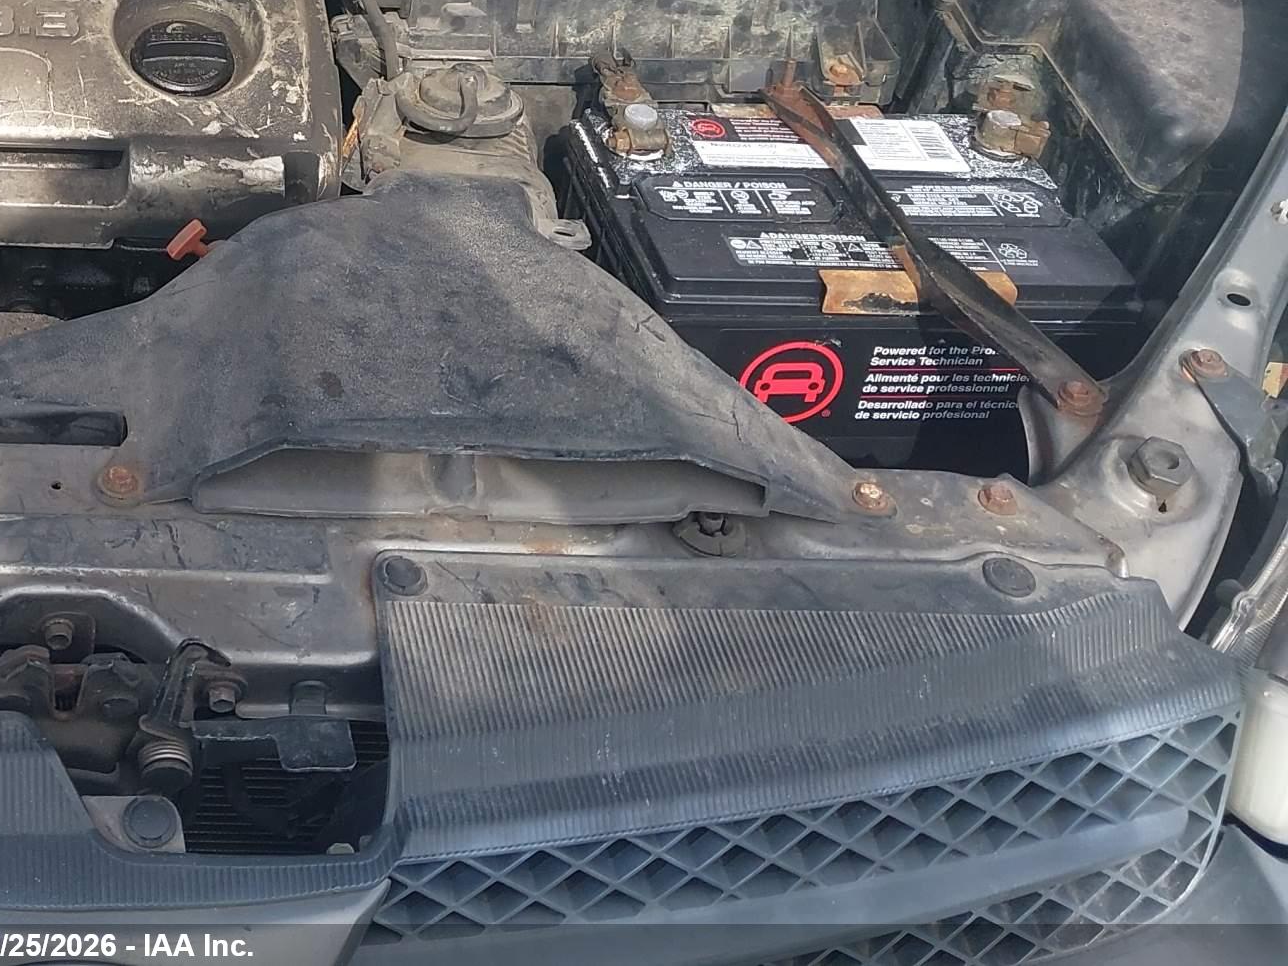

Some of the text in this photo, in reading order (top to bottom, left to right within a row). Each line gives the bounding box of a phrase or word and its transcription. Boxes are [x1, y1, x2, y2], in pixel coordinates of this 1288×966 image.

[683, 181, 733, 189] DANGER
[873, 346, 927, 356] Powered
[928, 346, 947, 356] for
[948, 346, 969, 356] the
[870, 356, 984, 367] Service Technician
[864, 373, 1030, 385] Alimenté pour les technicie
[862, 384, 1010, 395] de service professionnel
[857, 401, 933, 410] Desarrollado
[935, 402, 963, 411] para
[964, 400, 978, 410] el
[854, 410, 991, 421] de servicio profesional
